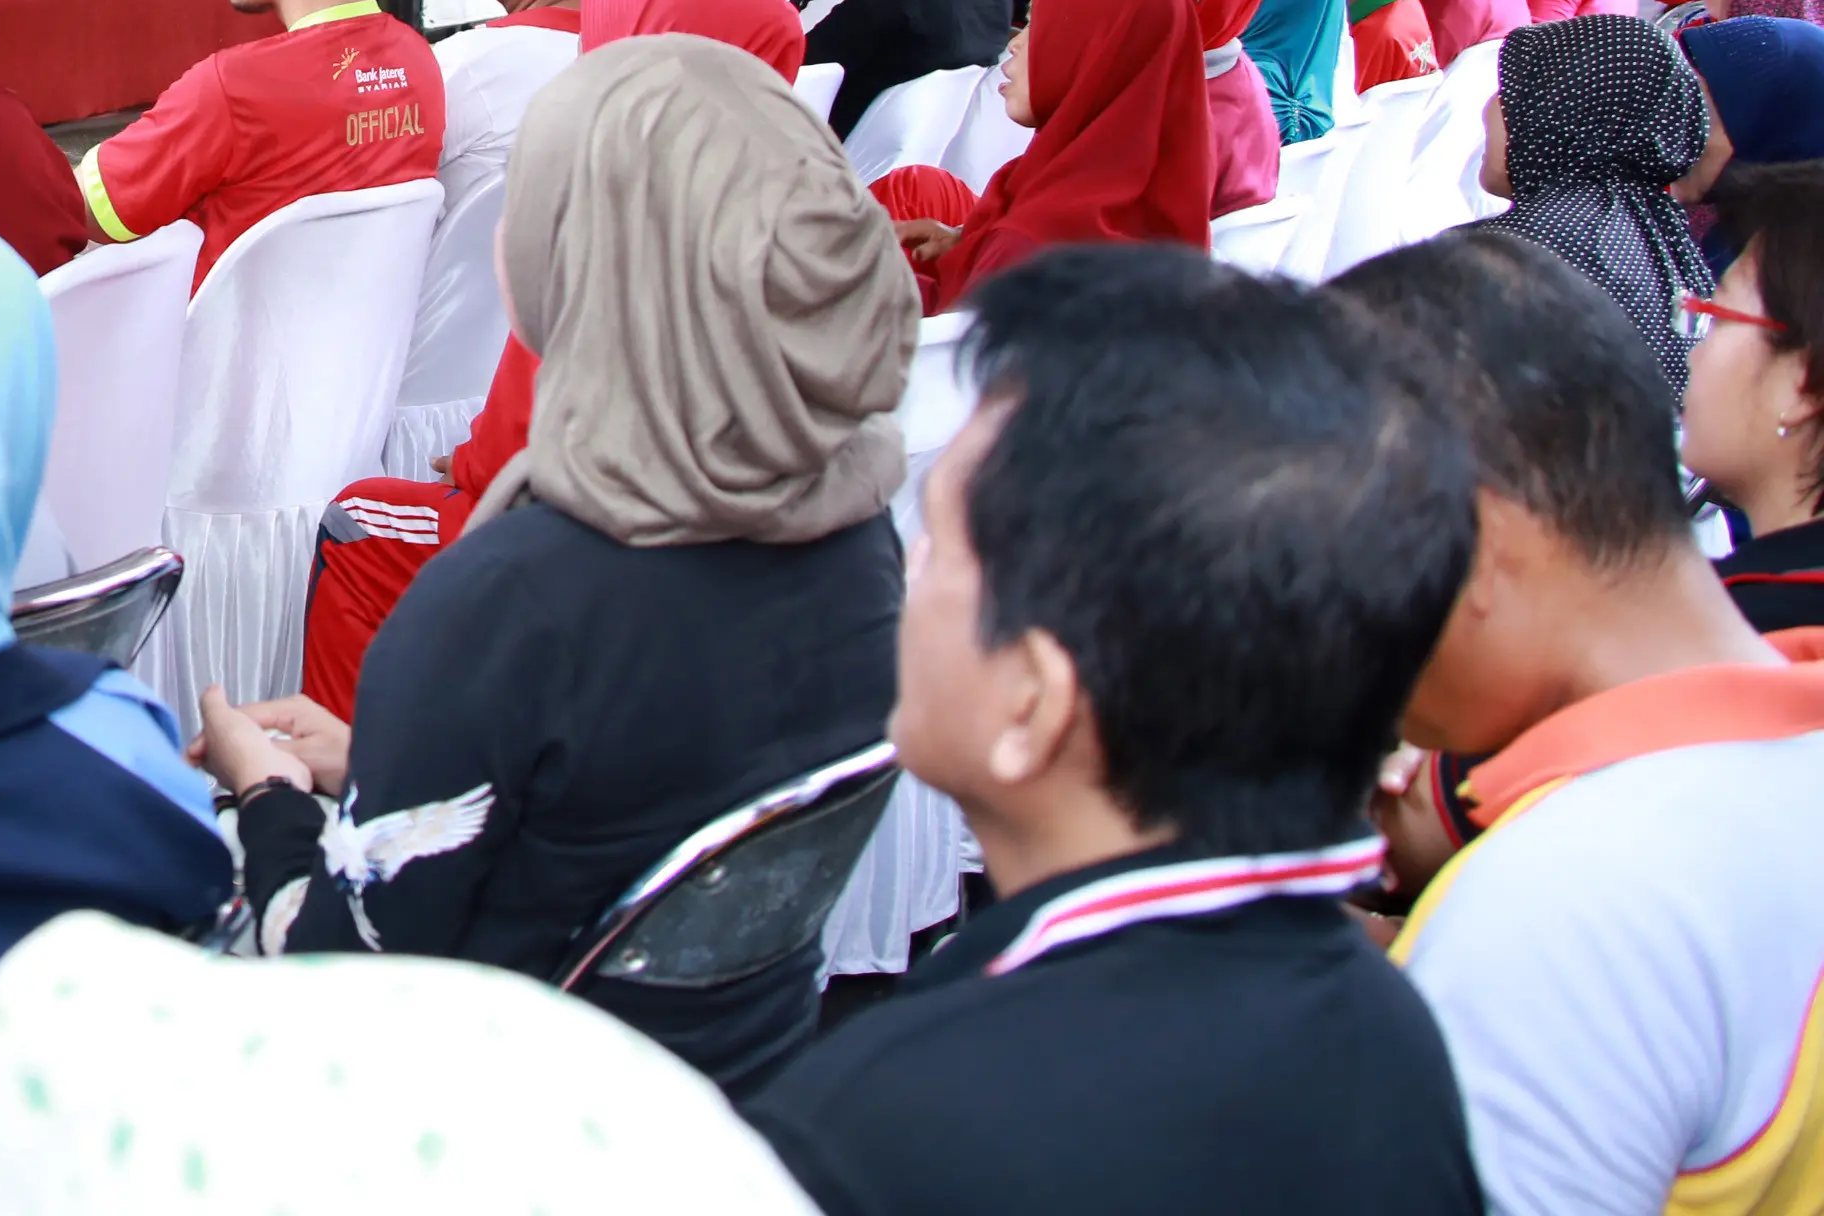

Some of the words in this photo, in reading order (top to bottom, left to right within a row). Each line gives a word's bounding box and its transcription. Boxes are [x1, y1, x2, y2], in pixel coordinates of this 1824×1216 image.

[355, 68, 378, 84] Bank
[379, 66, 407, 85] Jateng
[357, 81, 409, 94] SYARIAH
[346, 103, 425, 147] OFFICIAL
